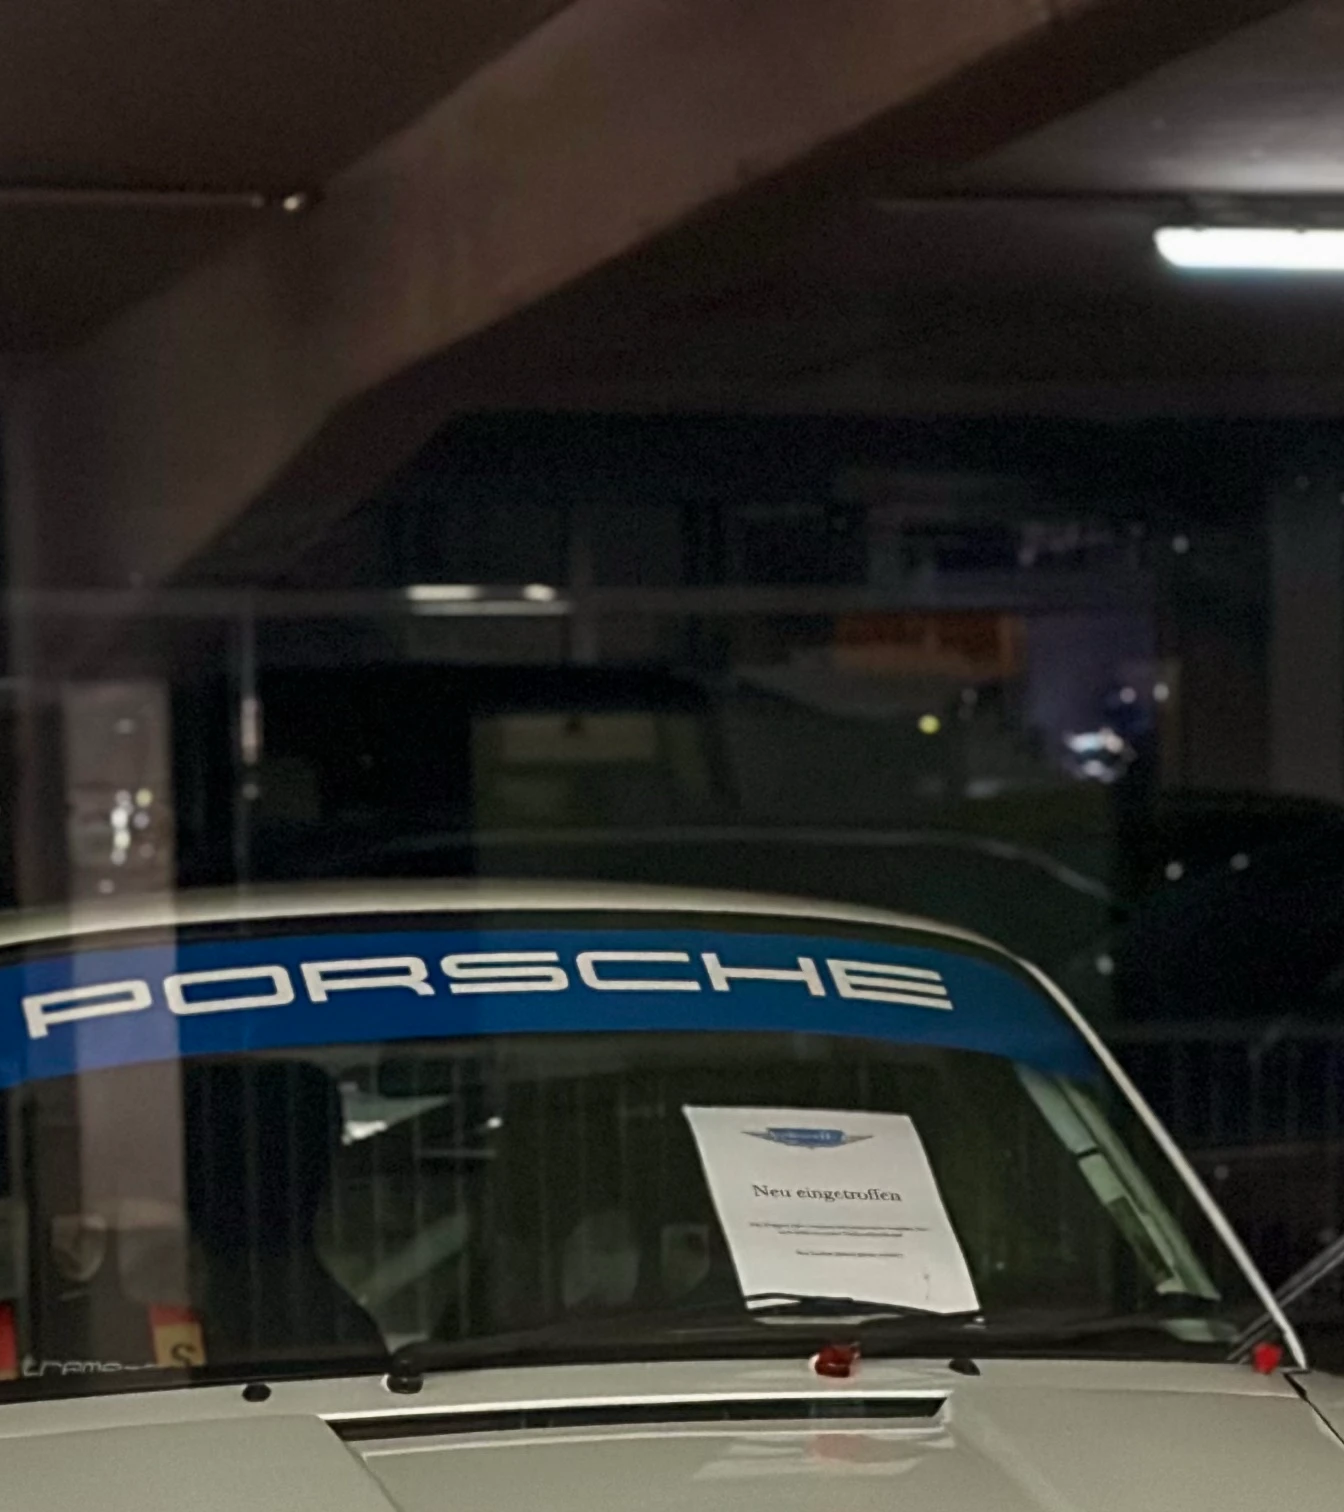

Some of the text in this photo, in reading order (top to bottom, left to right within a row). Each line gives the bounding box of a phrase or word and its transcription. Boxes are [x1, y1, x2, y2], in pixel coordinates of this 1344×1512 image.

[22, 950, 954, 1039] PORSCHE
[752, 1184, 903, 1203] Neu eingetroffen
